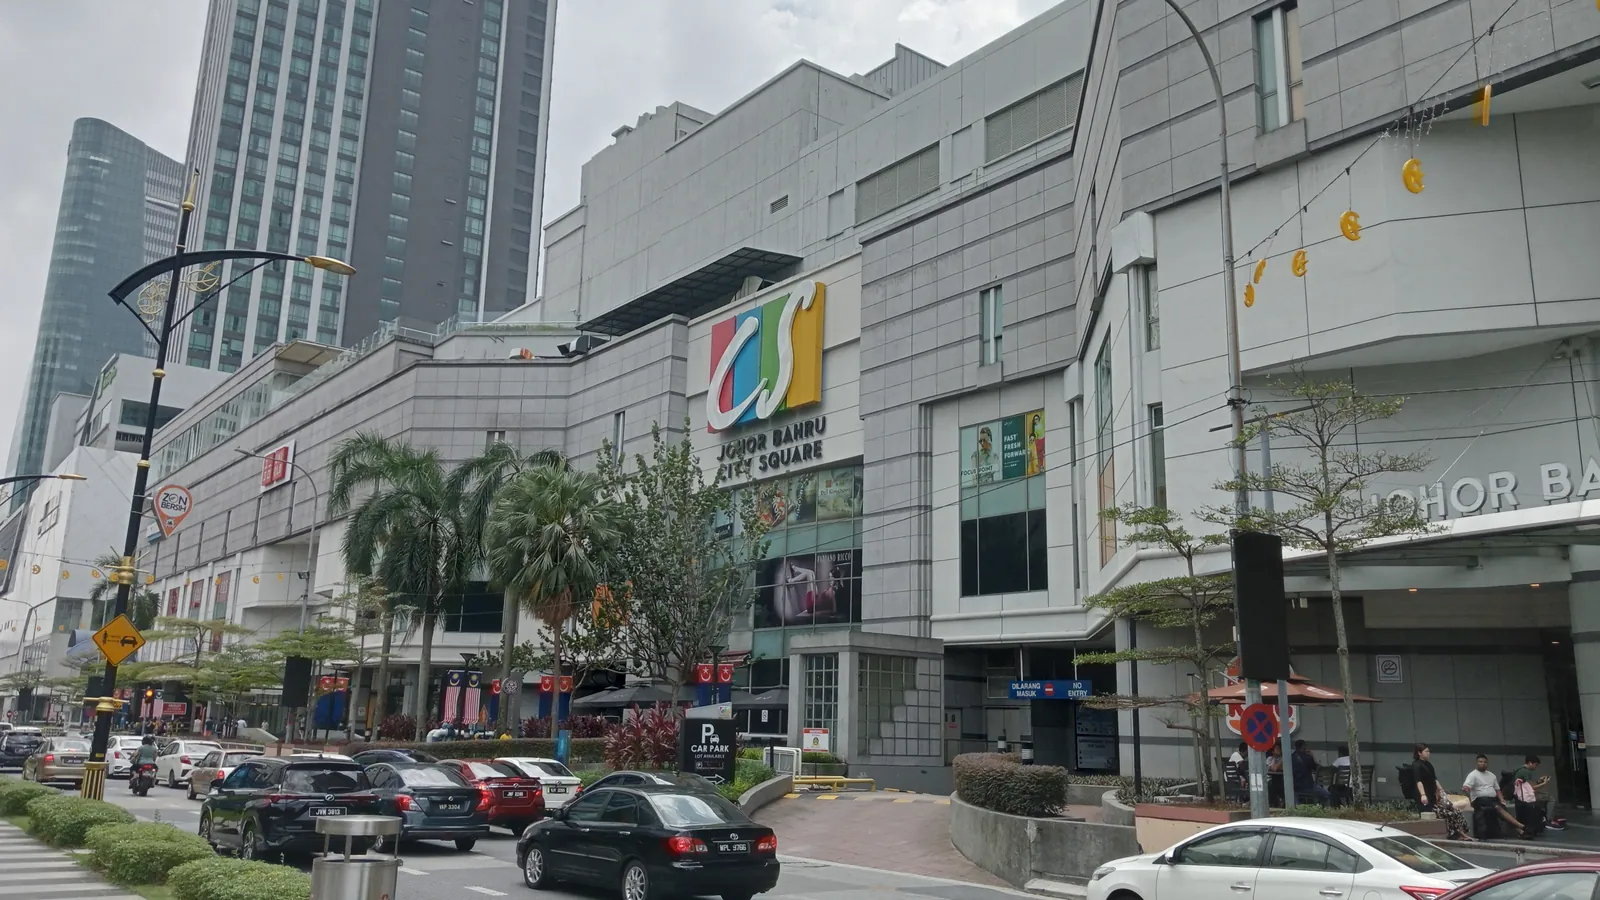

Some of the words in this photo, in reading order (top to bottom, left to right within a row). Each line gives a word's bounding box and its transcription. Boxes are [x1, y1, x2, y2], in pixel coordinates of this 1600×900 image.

[717, 433, 767, 461] JOHOR
[772, 416, 826, 447] BAHRU
[1003, 434, 1017, 443] FAST
[1004, 441, 1021, 451] FRESH
[759, 440, 822, 471] SQUARE
[162, 492, 188, 506] ZON
[160, 502, 187, 512] BERSIH
[701, 723, 715, 744] P
[690, 745, 708, 753] CAR
[709, 745, 730, 753] PARK
